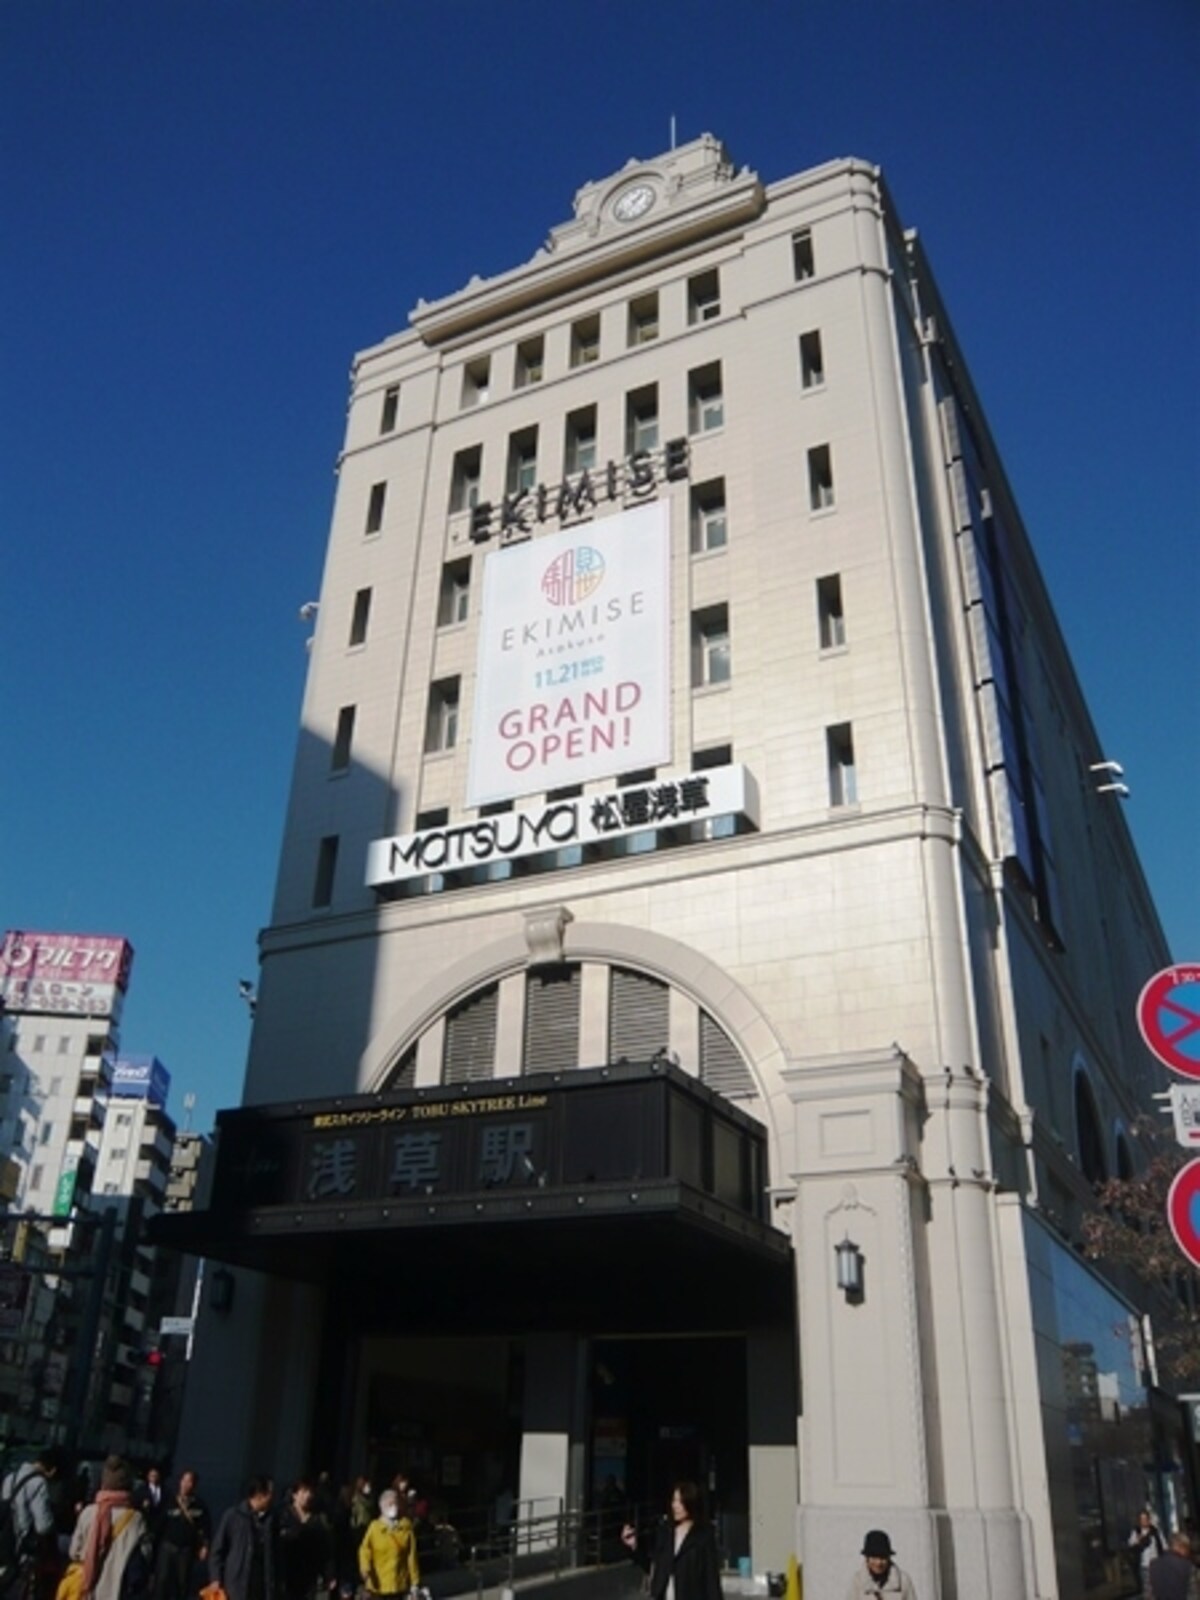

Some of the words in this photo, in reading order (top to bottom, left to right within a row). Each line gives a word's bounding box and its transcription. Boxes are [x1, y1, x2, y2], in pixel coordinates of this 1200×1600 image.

[469, 437, 690, 545] EKIMISE
[501, 591, 645, 652] EKIMISE
[498, 681, 642, 740] GRAND
[505, 716, 631, 772] OPEN!
[590, 776, 710, 832] 松屋浅草
[412, 1103, 449, 1119] TOBU
[308, 1122, 536, 1196] 浅草駅
